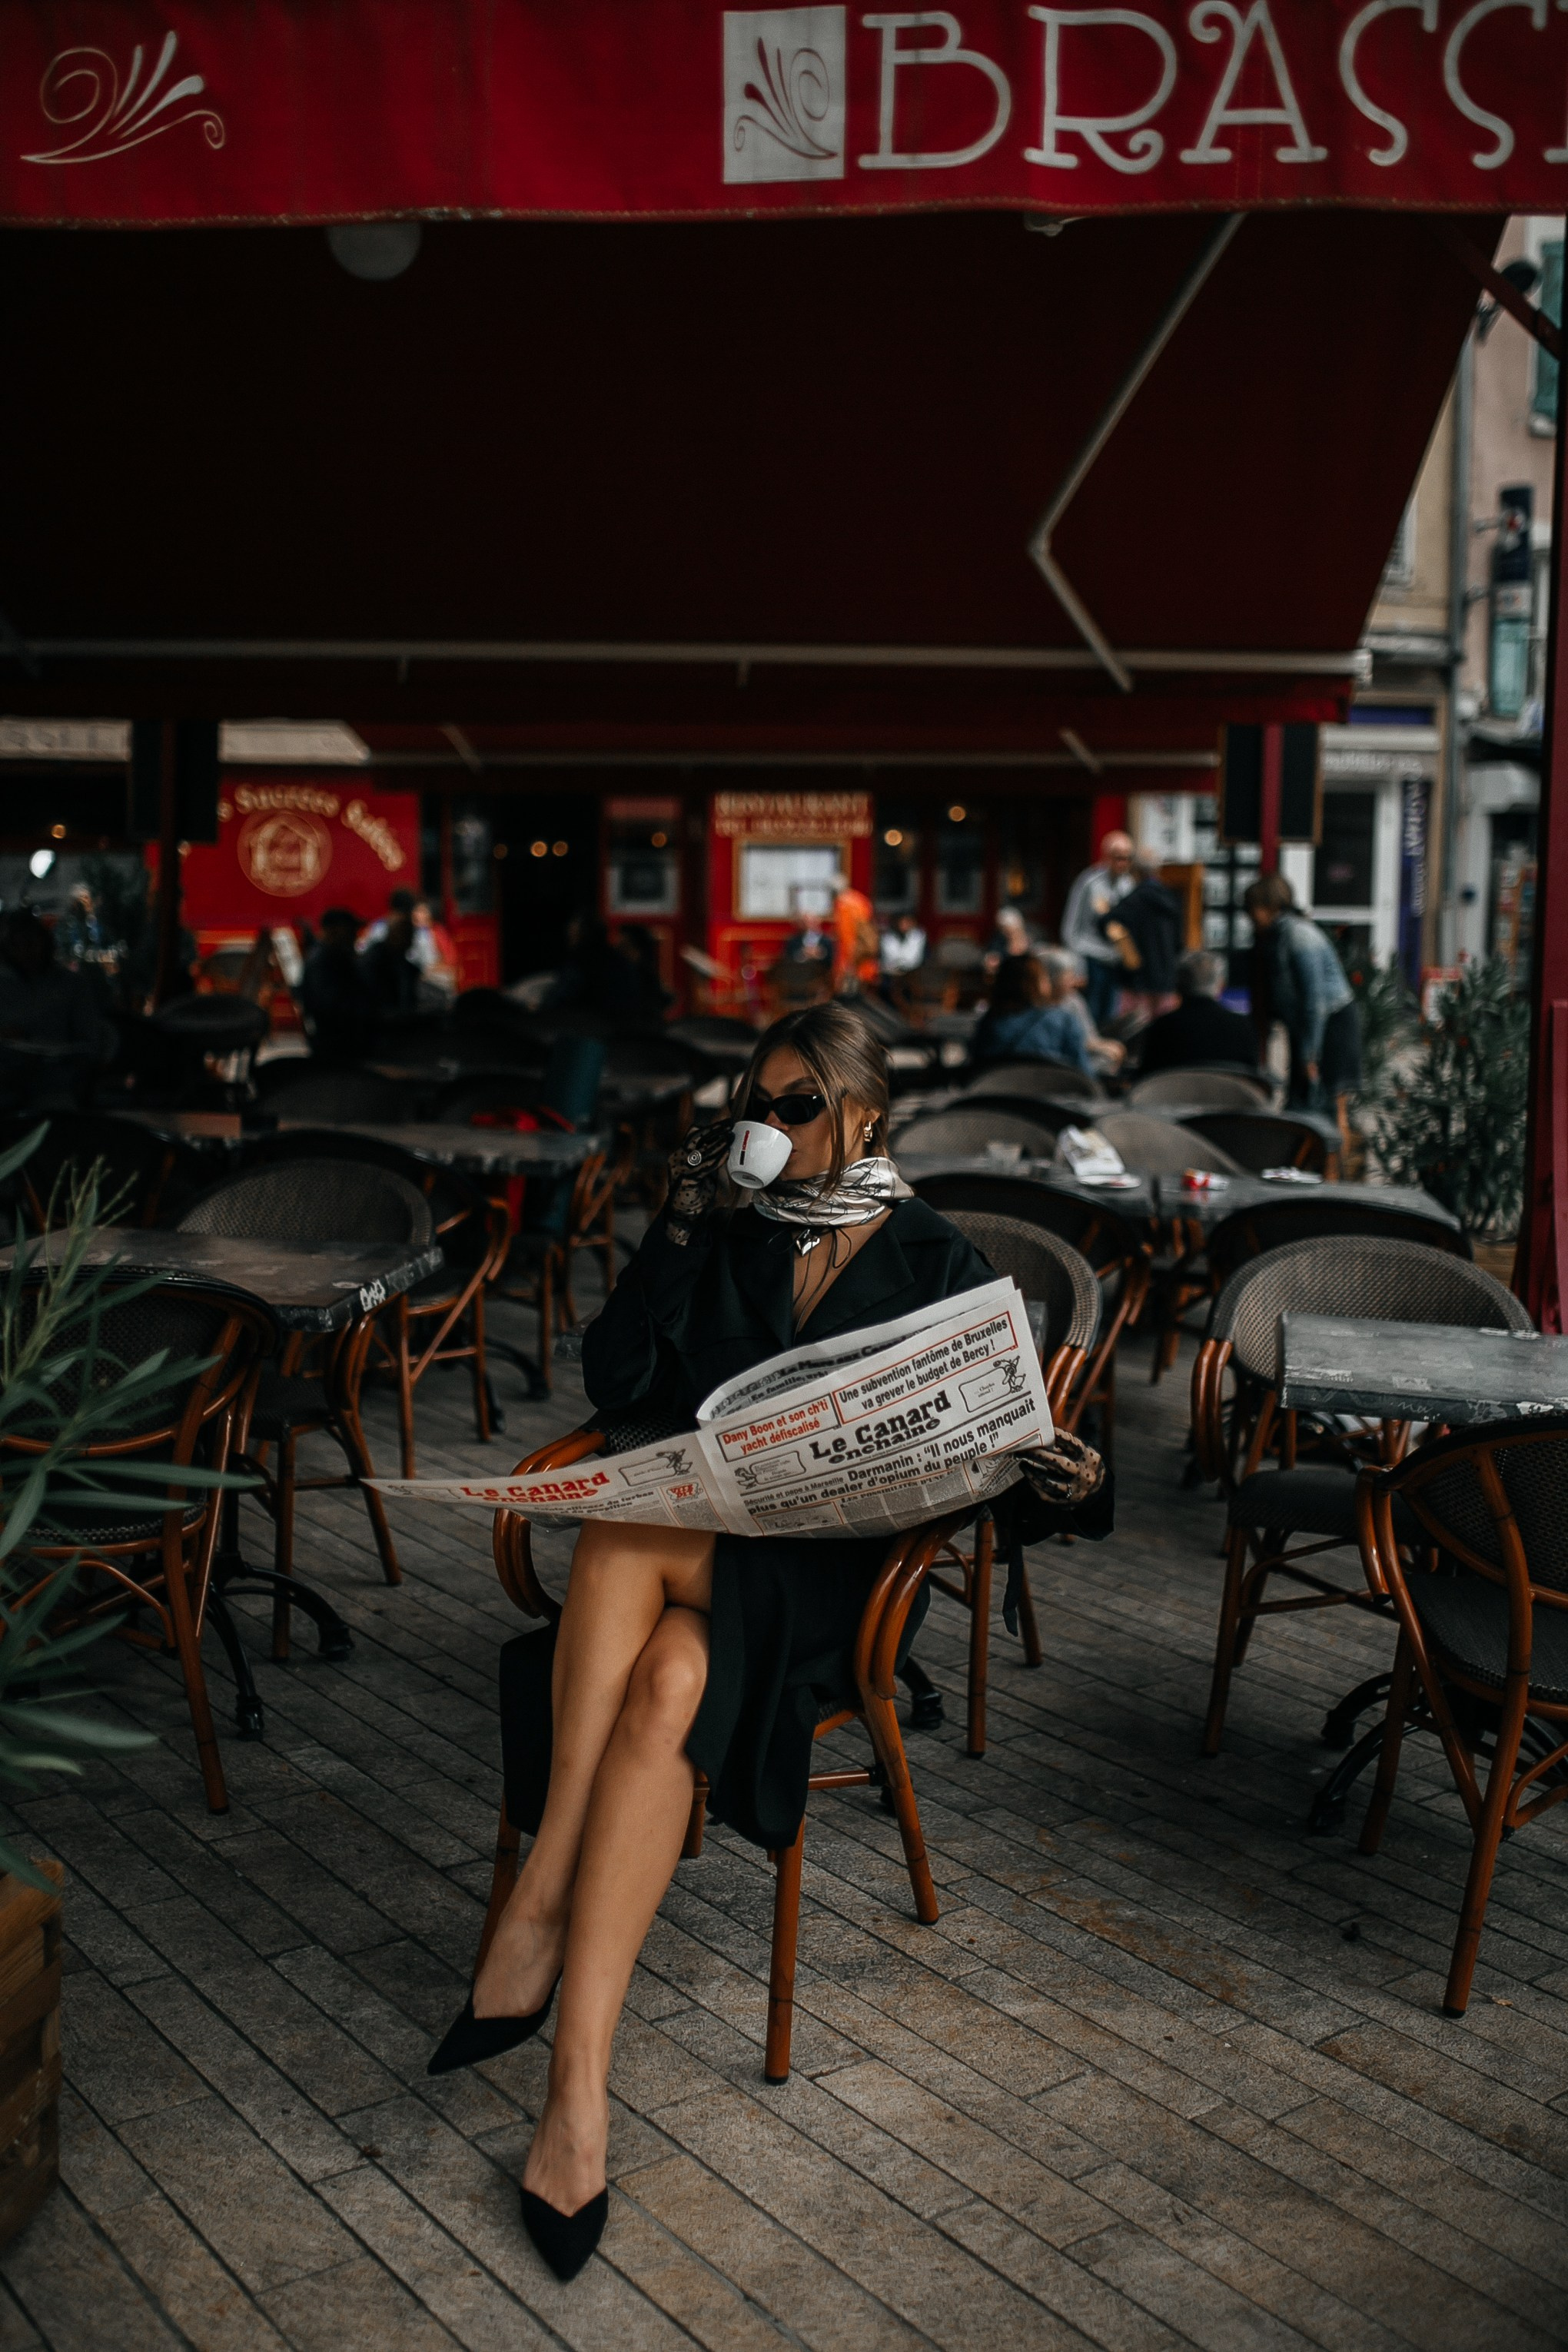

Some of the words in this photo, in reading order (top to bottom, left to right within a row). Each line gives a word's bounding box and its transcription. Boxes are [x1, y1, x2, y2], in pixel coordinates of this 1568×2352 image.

[859, 0, 1568, 174] BRASS
[839, 1390, 859, 1404] Une
[861, 1364, 912, 1394] subvention
[912, 1346, 949, 1375] fantôme
[951, 1337, 963, 1351] de
[964, 1318, 1008, 1347] Bruxelles
[861, 1398, 874, 1410] va
[875, 1384, 905, 1407] grever
[905, 1377, 916, 1390] le
[917, 1361, 949, 1386] budget
[950, 1355, 962, 1370] de
[962, 1344, 989, 1364] Bercy
[990, 1339, 995, 1351] !
[722, 1430, 749, 1445] Dany
[749, 1420, 775, 1437] Boon
[776, 1415, 787, 1427] et
[789, 1410, 806, 1423] son
[808, 1399, 829, 1416] ch'ti
[740, 1437, 768, 1455] yacht
[769, 1418, 821, 1444] défiscalisé
[784, 1487, 803, 1498] pape
[810, 1476, 845, 1491] Marseille
[847, 1455, 913, 1482] Darmanin
[915, 1451, 922, 1463] :
[943, 1430, 975, 1454] nous
[977, 1398, 1036, 1438] manquait
[809, 1436, 848, 1460] Le
[855, 1390, 952, 1445] Canard
[460, 1485, 500, 1497] Le
[506, 1471, 610, 1497] Canard
[747, 1503, 777, 1516] plus
[779, 1493, 818, 1511] qu'un
[820, 1481, 864, 1500] dealer
[867, 1469, 922, 1488] d'opium
[923, 1460, 941, 1473] du
[944, 1442, 988, 1470] peuple
